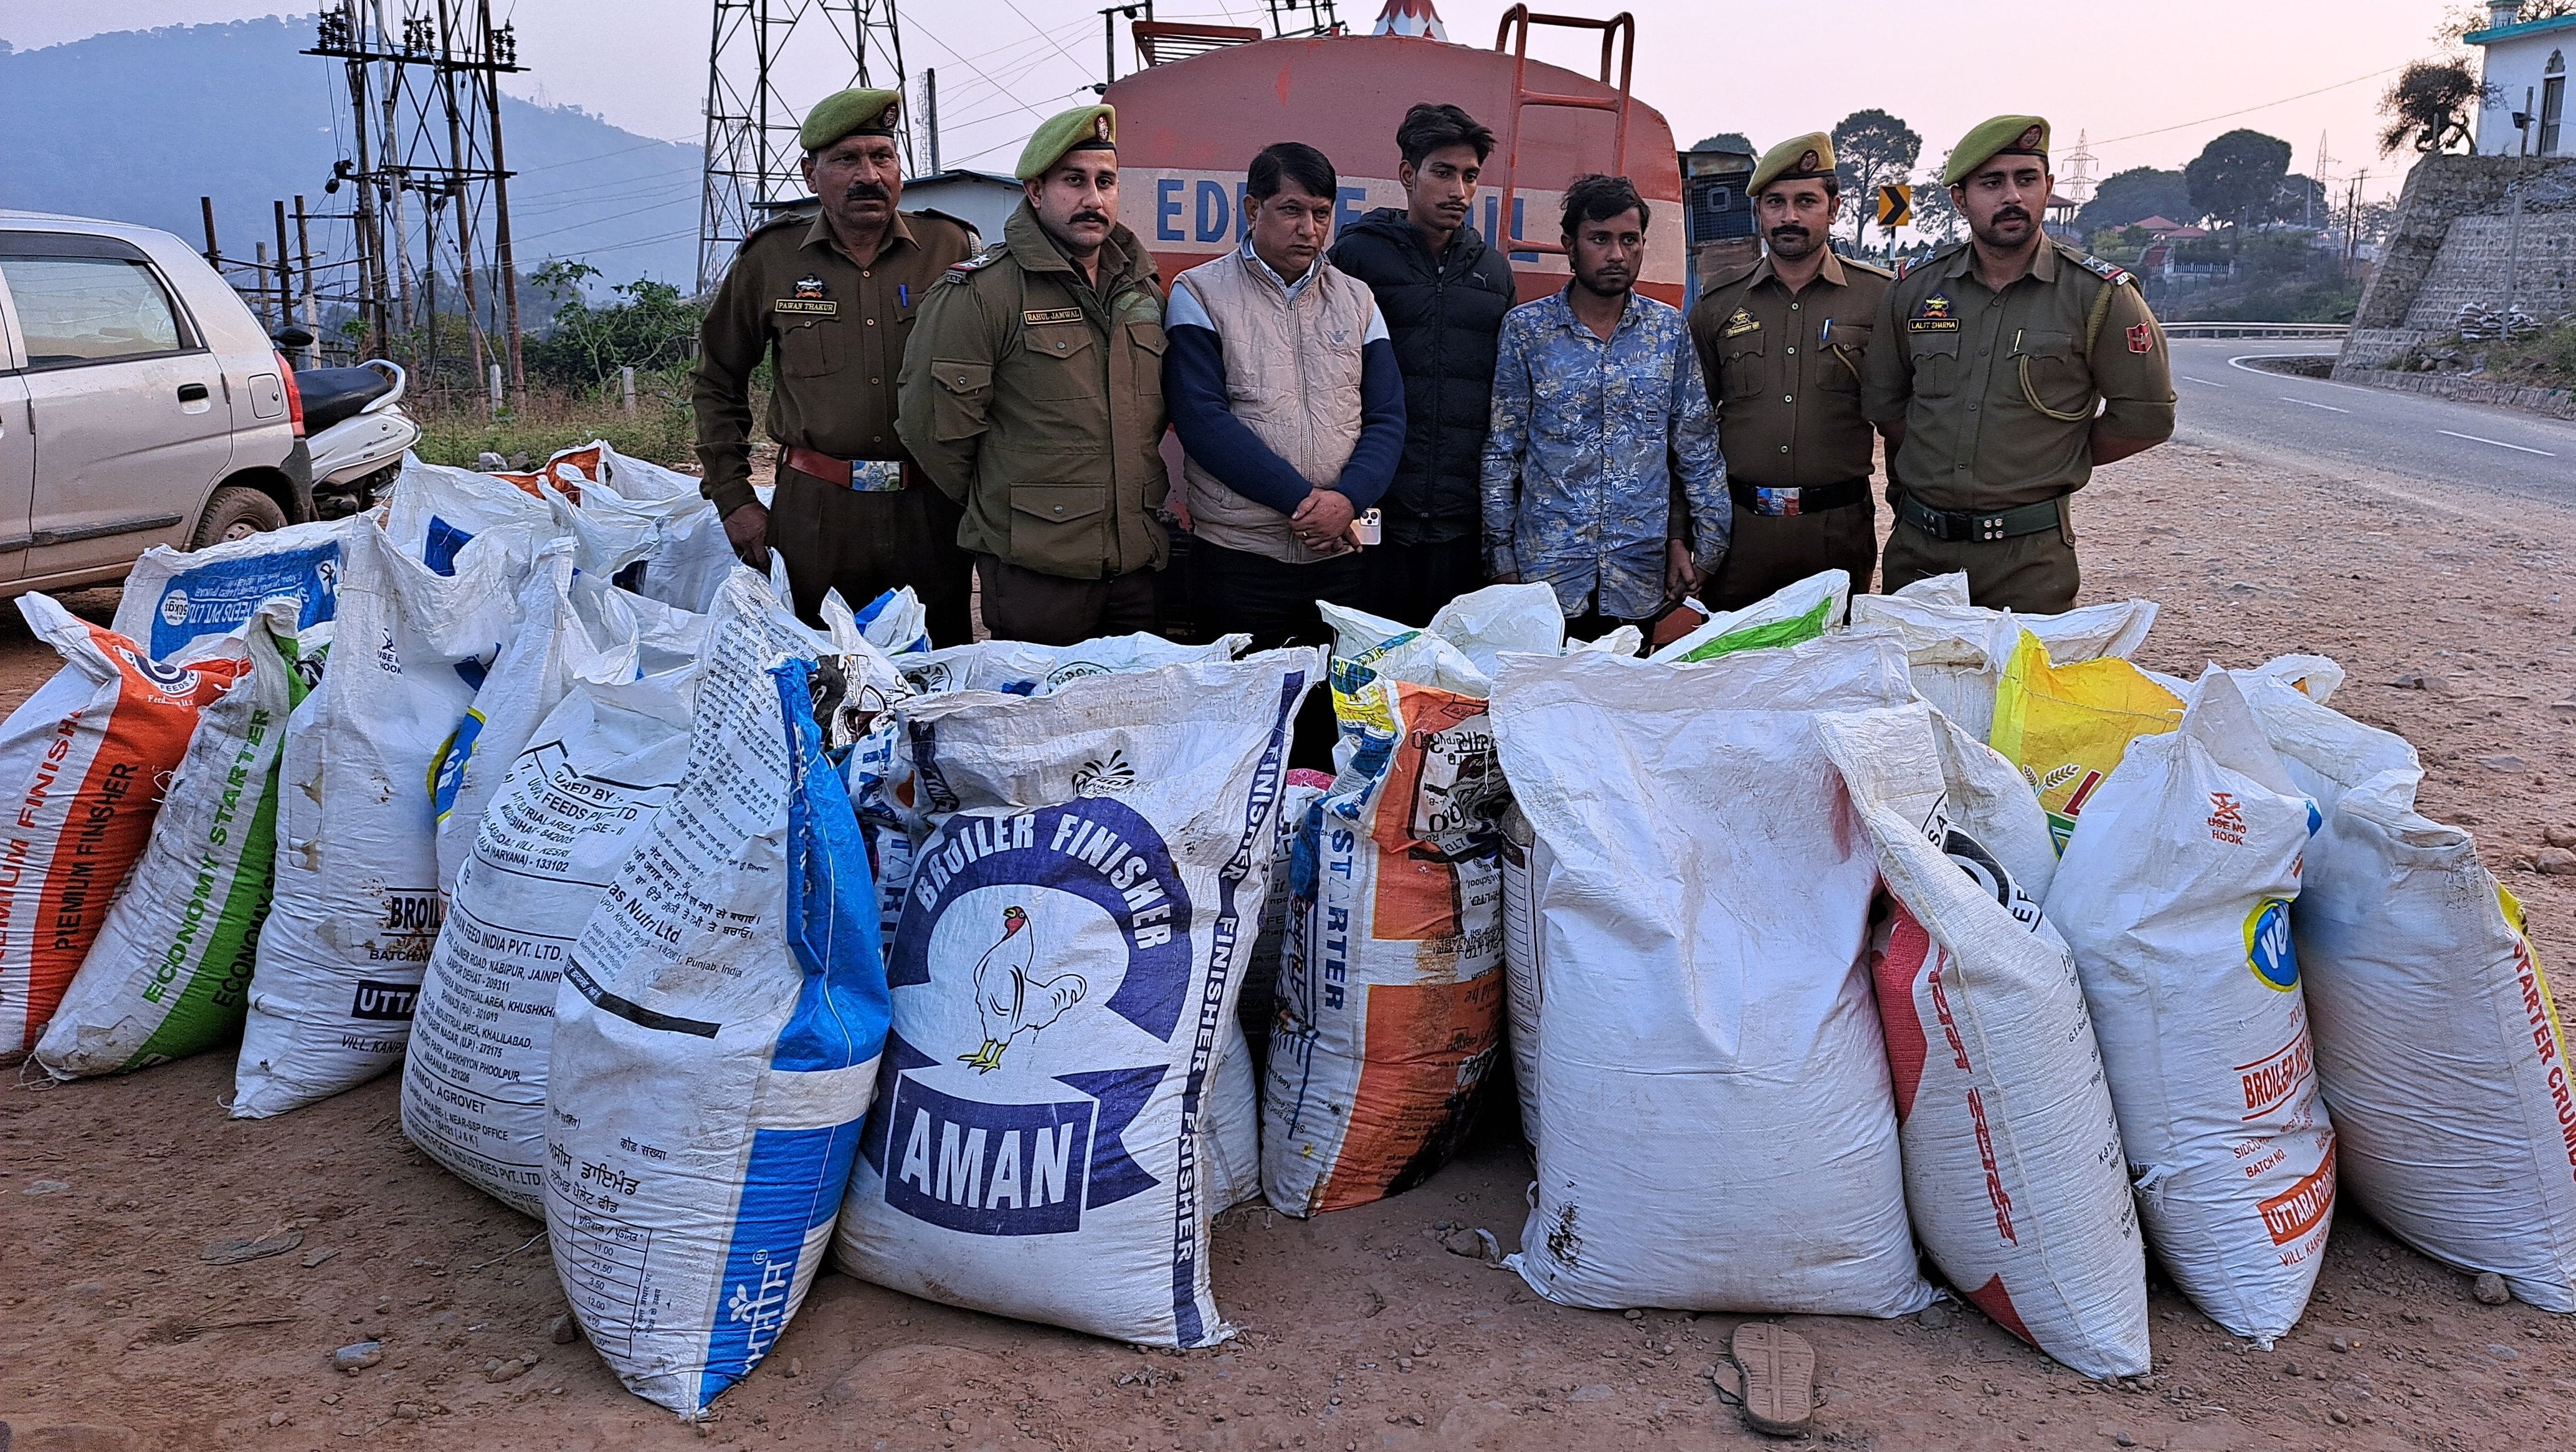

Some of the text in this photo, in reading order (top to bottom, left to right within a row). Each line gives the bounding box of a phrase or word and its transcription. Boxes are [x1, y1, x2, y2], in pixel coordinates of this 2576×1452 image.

[1157, 178, 1366, 242] EDIE
[778, 302, 834, 311] PAWAN THAKUR
[1027, 310, 1080, 321] RAHUL JAMWAL
[160, 680, 189, 692] FEEDS
[592, 788, 615, 803] BY
[76, 762, 140, 856] FINISHER
[541, 792, 588, 821] FEEDS
[2207, 816, 2247, 836] USE NO
[2211, 829, 2244, 846] HOOK
[143, 708, 270, 1004] ECONOMY STARTER
[539, 845, 572, 857] KESRI
[649, 846, 662, 861] नेट
[535, 857, 569, 872] 133102
[643, 861, 665, 882] जगह
[662, 879, 676, 894] पर
[715, 908, 728, 920] से
[914, 813, 1034, 914] BROILER
[1049, 813, 1172, 951] FINISHER
[607, 880, 683, 946] as Nutri Ltd.
[1324, 829, 1355, 1012] STARTER
[481, 932, 505, 952] INDIA
[507, 939, 531, 958] PVT.
[534, 944, 563, 962] LTD.
[599, 896, 615, 914] VPO
[613, 911, 633, 934] Khosa
[685, 956, 718, 972] Punjab,
[720, 965, 743, 978] India
[463, 968, 483, 985] DEHAT
[485, 977, 510, 993] 209311
[488, 960, 526, 981] NABIPUR,
[483, 995, 506, 1011] AREA,
[1192, 915, 1239, 1072] FINISHER
[2513, 938, 2555, 1066] STARTER
[475, 1006, 499, 1023] 301019
[342, 1034, 369, 1052] VILL.
[481, 1028, 533, 1050] KHALILABAD,
[478, 1042, 503, 1059] 272175
[478, 1061, 521, 1084] PHOOLPUR,
[2242, 1053, 2295, 1110] BROILER
[411, 1062, 487, 1115] ANMOL AGROVET
[482, 1125, 509, 1142] OFFICE
[620, 1136, 667, 1160] कोड संख्या
[899, 1106, 1075, 1211] AMAN
[2245, 1148, 2288, 1179] BATCH NO.
[498, 1167, 520, 1184] PVT.
[521, 1172, 544, 1187] LTD.
[597, 1195, 620, 1214] ਫੀਡ
[2267, 1188, 2318, 1235] UTTARA
[592, 1243, 614, 1257] 11.00
[2278, 1248, 2306, 1267] VILL.
[591, 1259, 613, 1274] 21.50
[588, 1277, 605, 1291] 3.50
[587, 1296, 606, 1311] 12.00
